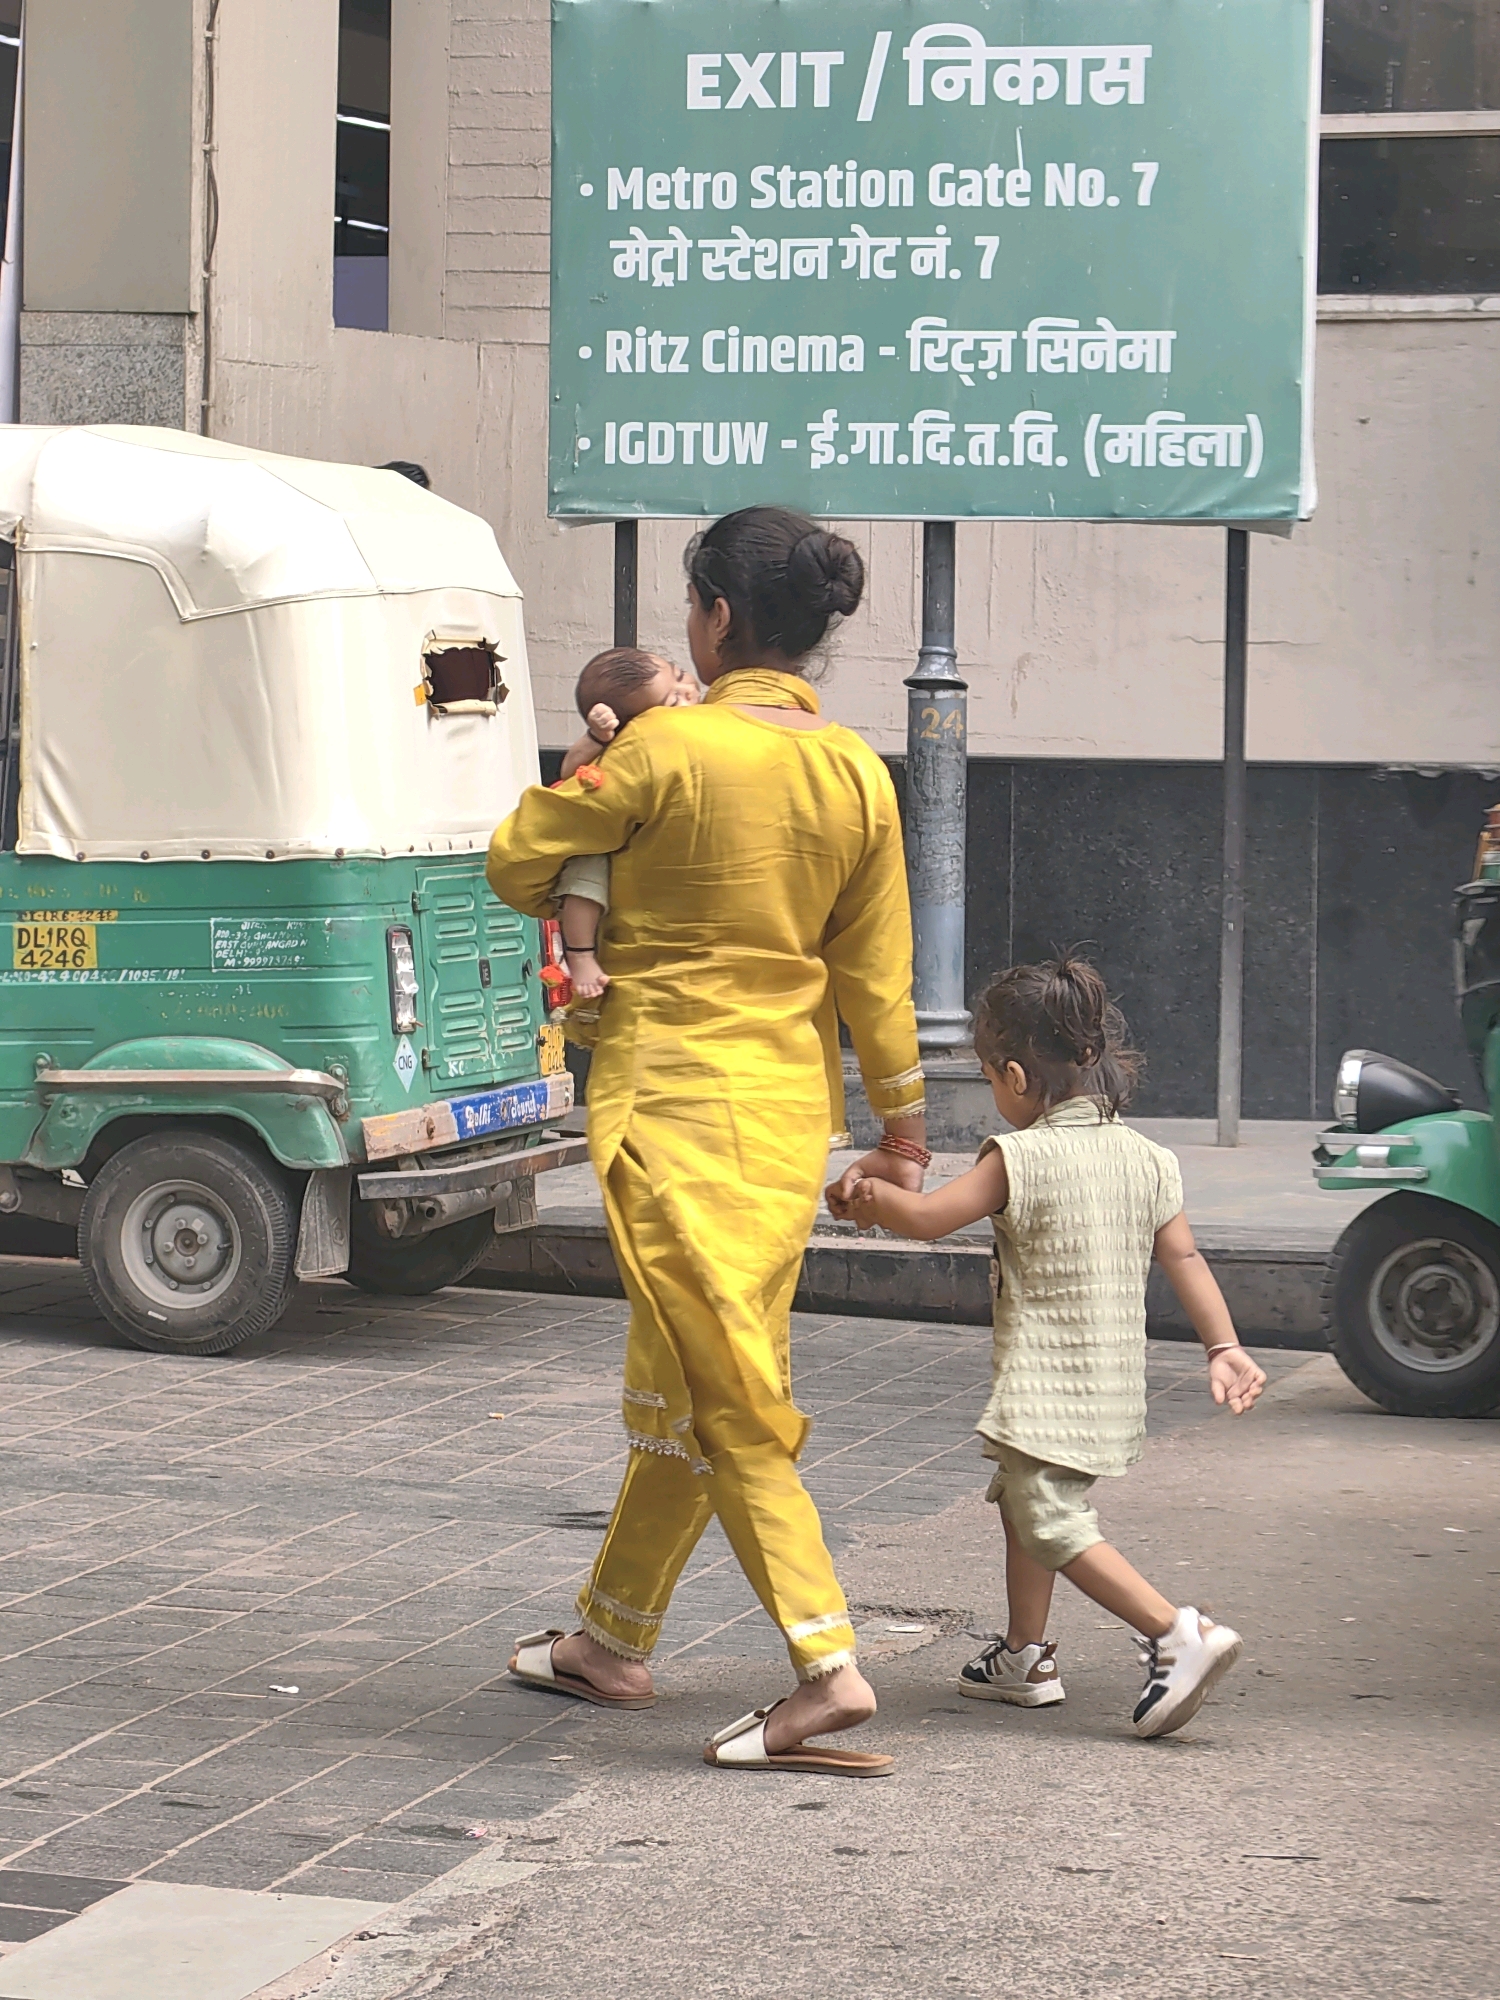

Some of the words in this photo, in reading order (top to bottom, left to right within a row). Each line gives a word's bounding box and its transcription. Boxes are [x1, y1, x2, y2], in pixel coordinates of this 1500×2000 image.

[686, 51, 845, 110] EXIT
[903, 23, 1153, 105] निकास
[607, 167, 738, 210] Metro
[751, 160, 915, 209] Station
[929, 163, 1031, 208] Gate
[1044, 162, 1121, 208] No.
[1132, 162, 1160, 206] 7
[610, 226, 692, 287] मेट्रो
[698, 226, 833, 281] स्टेशन
[840, 224, 901, 280] गेट
[906, 225, 962, 280] नं.
[975, 236, 1000, 280] 7
[605, 326, 690, 373] Ritz
[702, 326, 865, 373] Cinema
[906, 317, 1018, 386] रिट्ज़
[1022, 317, 1178, 375] सिनेमा
[604, 421, 769, 466] IGDTUW
[1083, 411, 1264, 478] (महिला)
[20, 949, 87, 968] 4246
[398, 1055, 413, 1070] CNG
